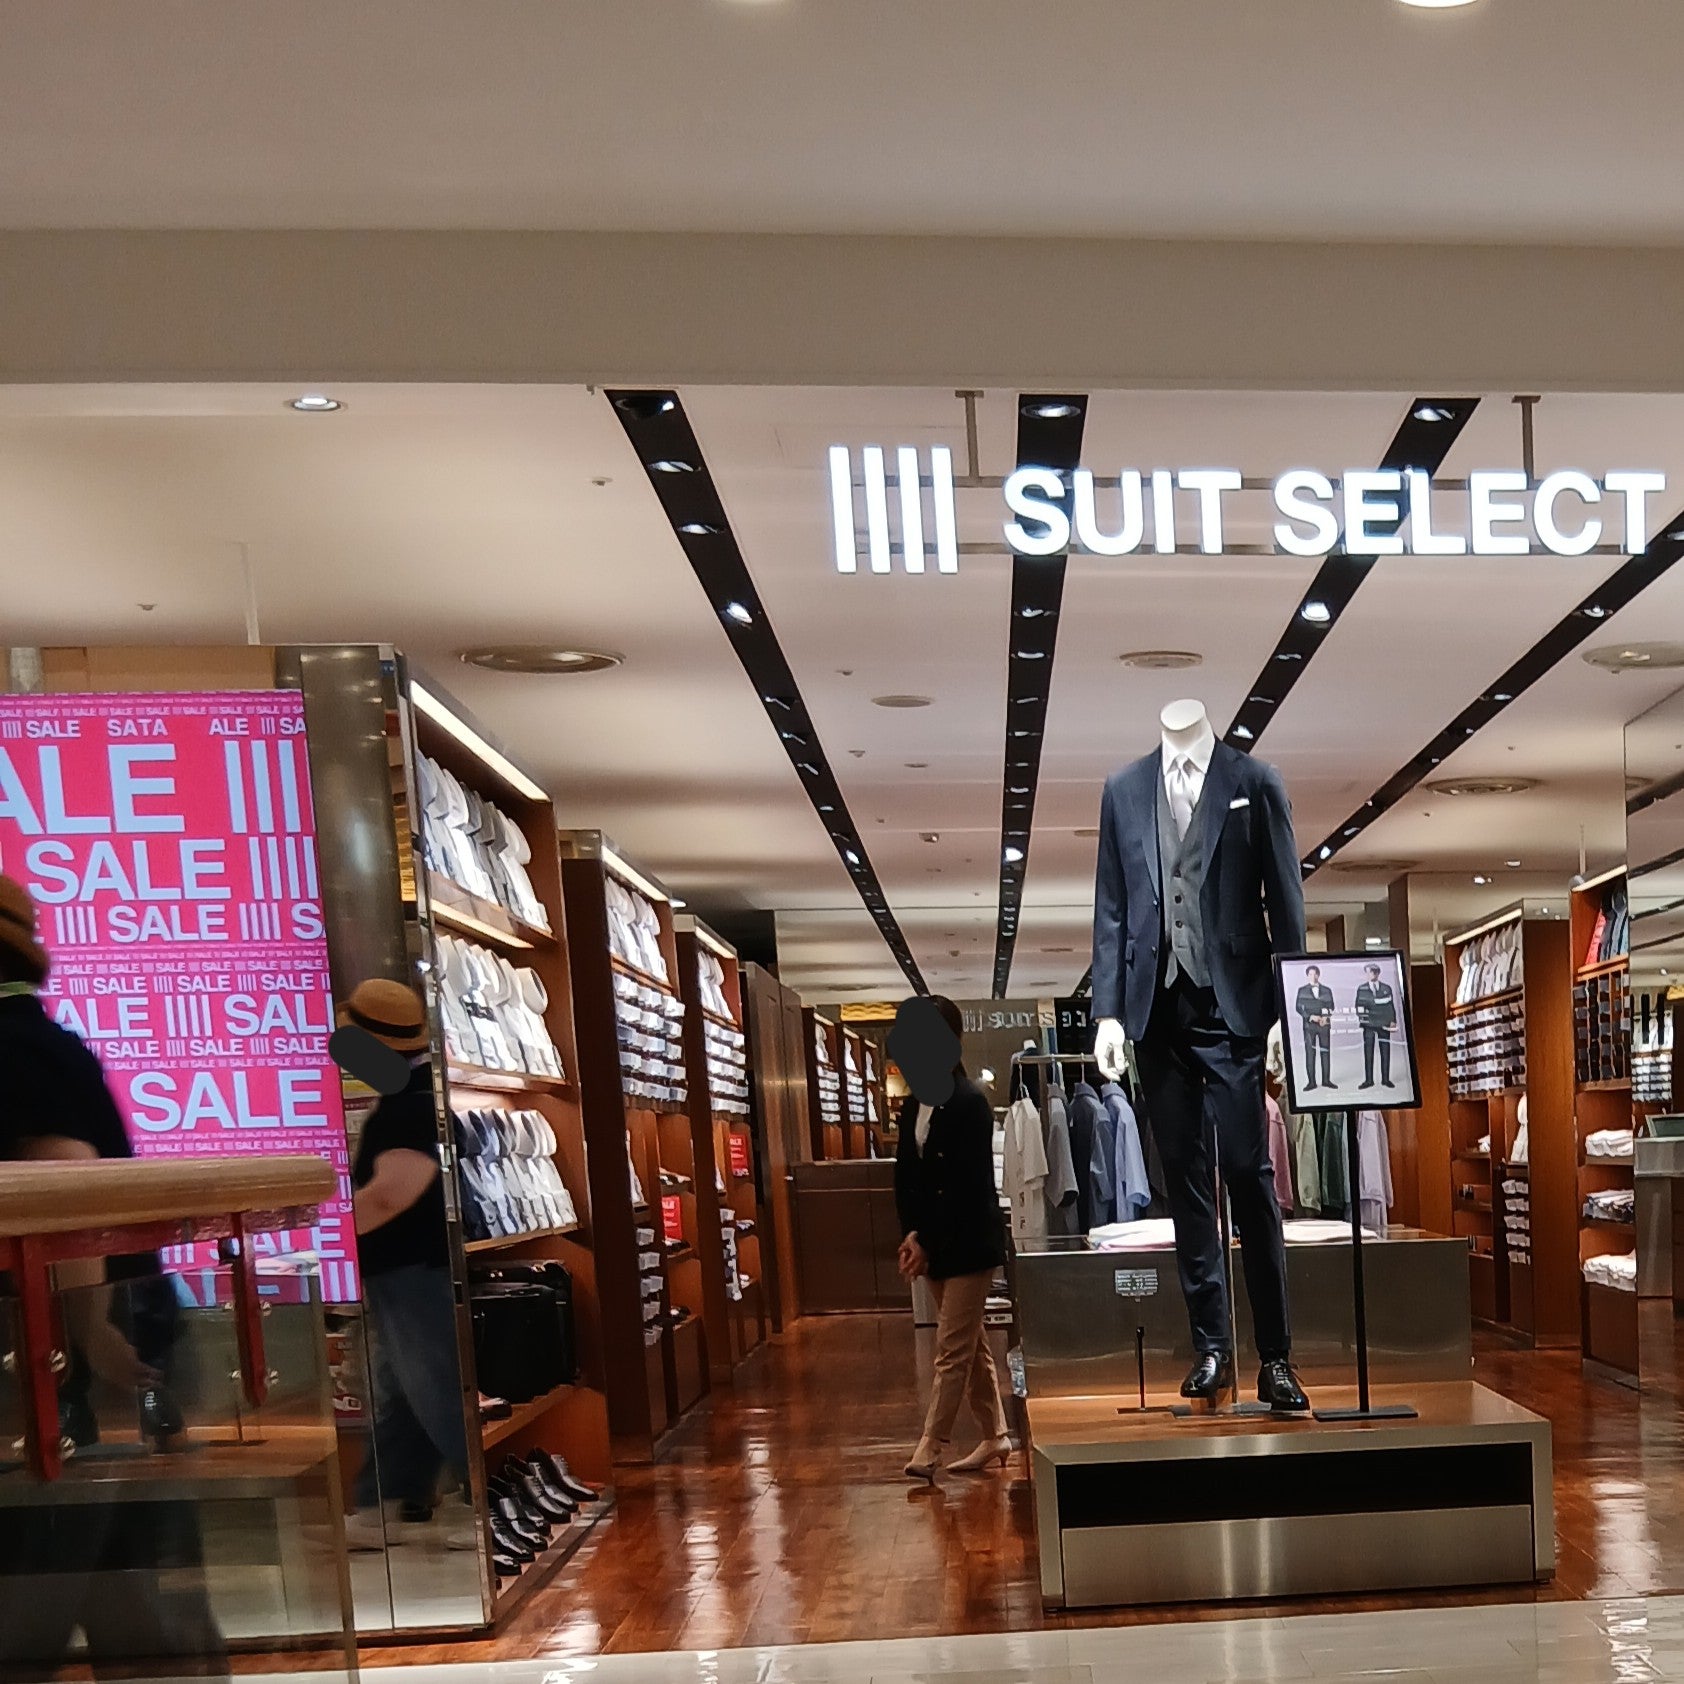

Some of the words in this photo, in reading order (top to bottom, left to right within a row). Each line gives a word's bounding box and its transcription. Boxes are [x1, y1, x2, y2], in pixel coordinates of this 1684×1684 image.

[1002, 466, 1242, 556] SUIT
[1273, 470, 1666, 556] SELECT
[26, 720, 81, 738] SALE
[107, 718, 168, 737] SATA
[209, 718, 250, 735] ALE
[26, 839, 231, 903] SALE
[108, 904, 229, 942] SALE
[291, 902, 327, 940] S
[63, 964, 93, 974] SALE
[109, 963, 140, 973] SALE
[155, 962, 186, 973] SALE
[202, 961, 233, 972] SALE
[247, 960, 279, 970] SALE
[294, 959, 323, 970] SALE
[92, 977, 148, 994] SALE
[177, 975, 232, 992] SALE
[261, 973, 315, 991] SALE
[42, 996, 154, 1039] ALE
[105, 1041, 160, 1058] SALE
[190, 1039, 244, 1057] SALE
[274, 1037, 327, 1054] SALE
[129, 1069, 328, 1132] SALE
